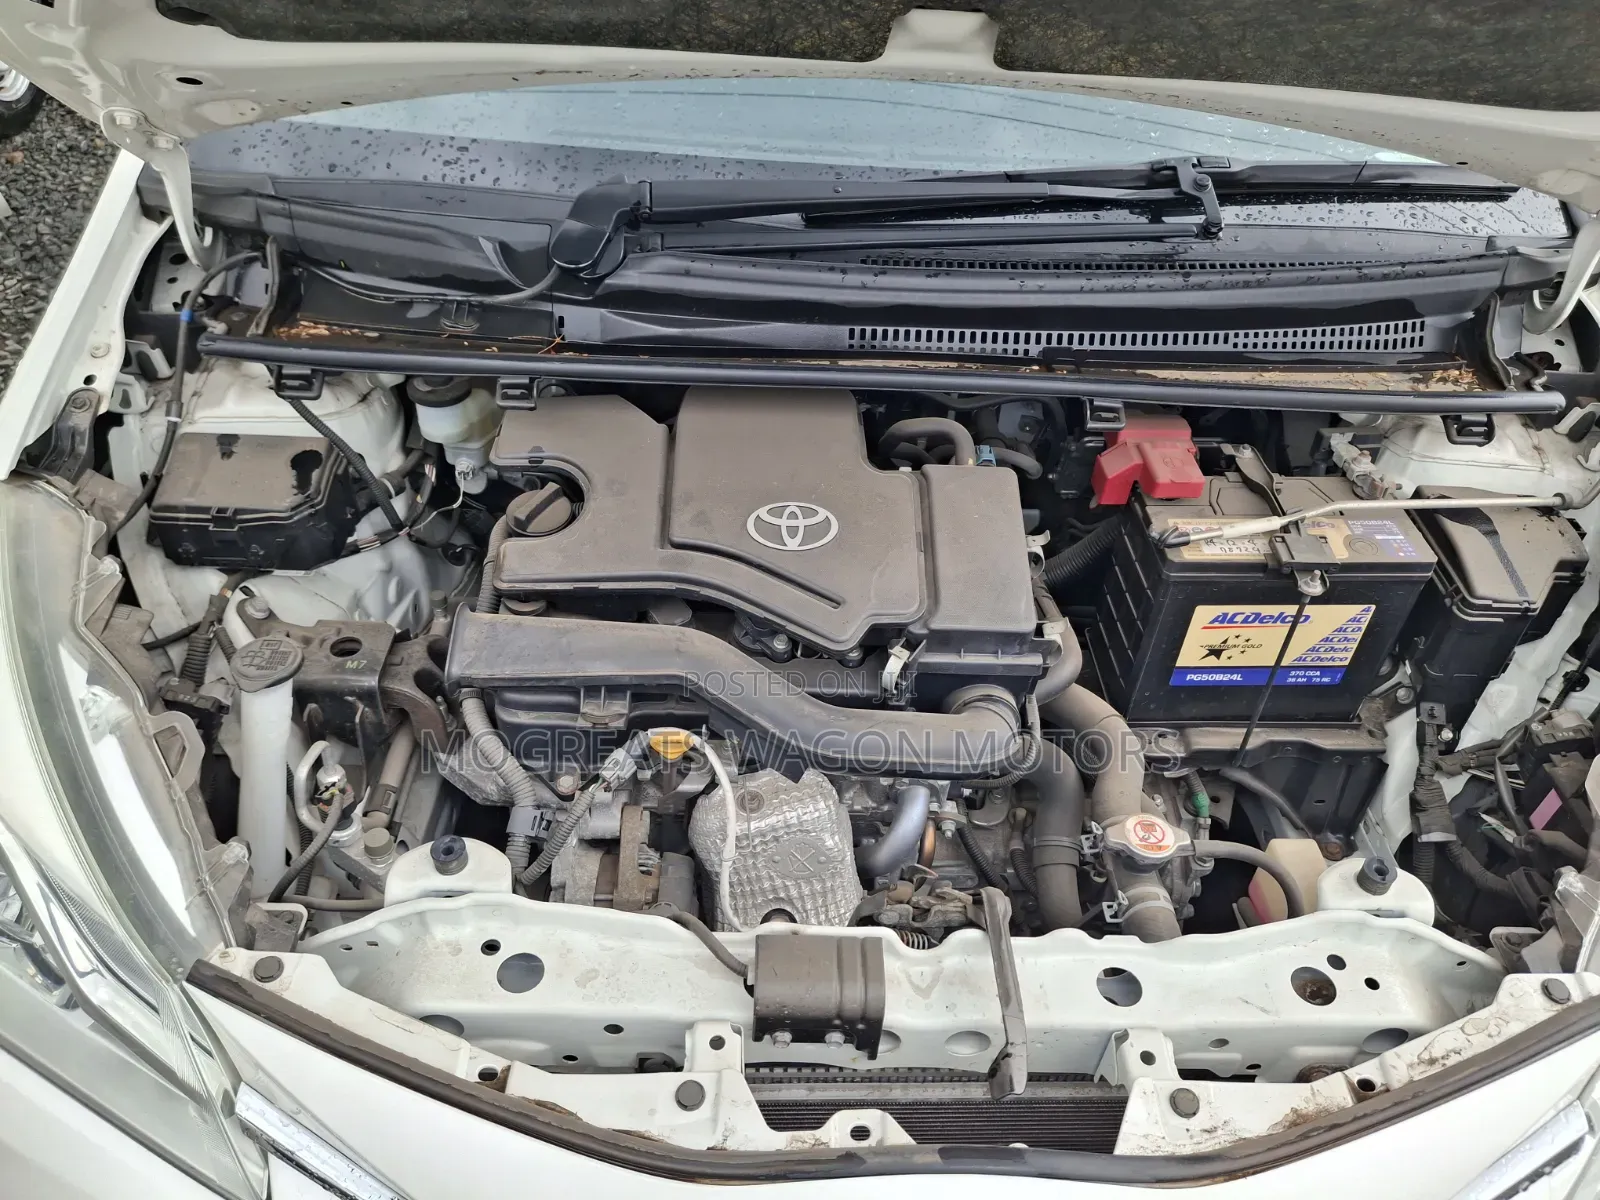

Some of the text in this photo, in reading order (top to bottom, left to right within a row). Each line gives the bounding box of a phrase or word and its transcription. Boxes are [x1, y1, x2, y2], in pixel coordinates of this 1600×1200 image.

[1208, 612, 1311, 624] ACDelco
[344, 660, 367, 669] M7
[1186, 673, 1243, 681] PG50B24L
